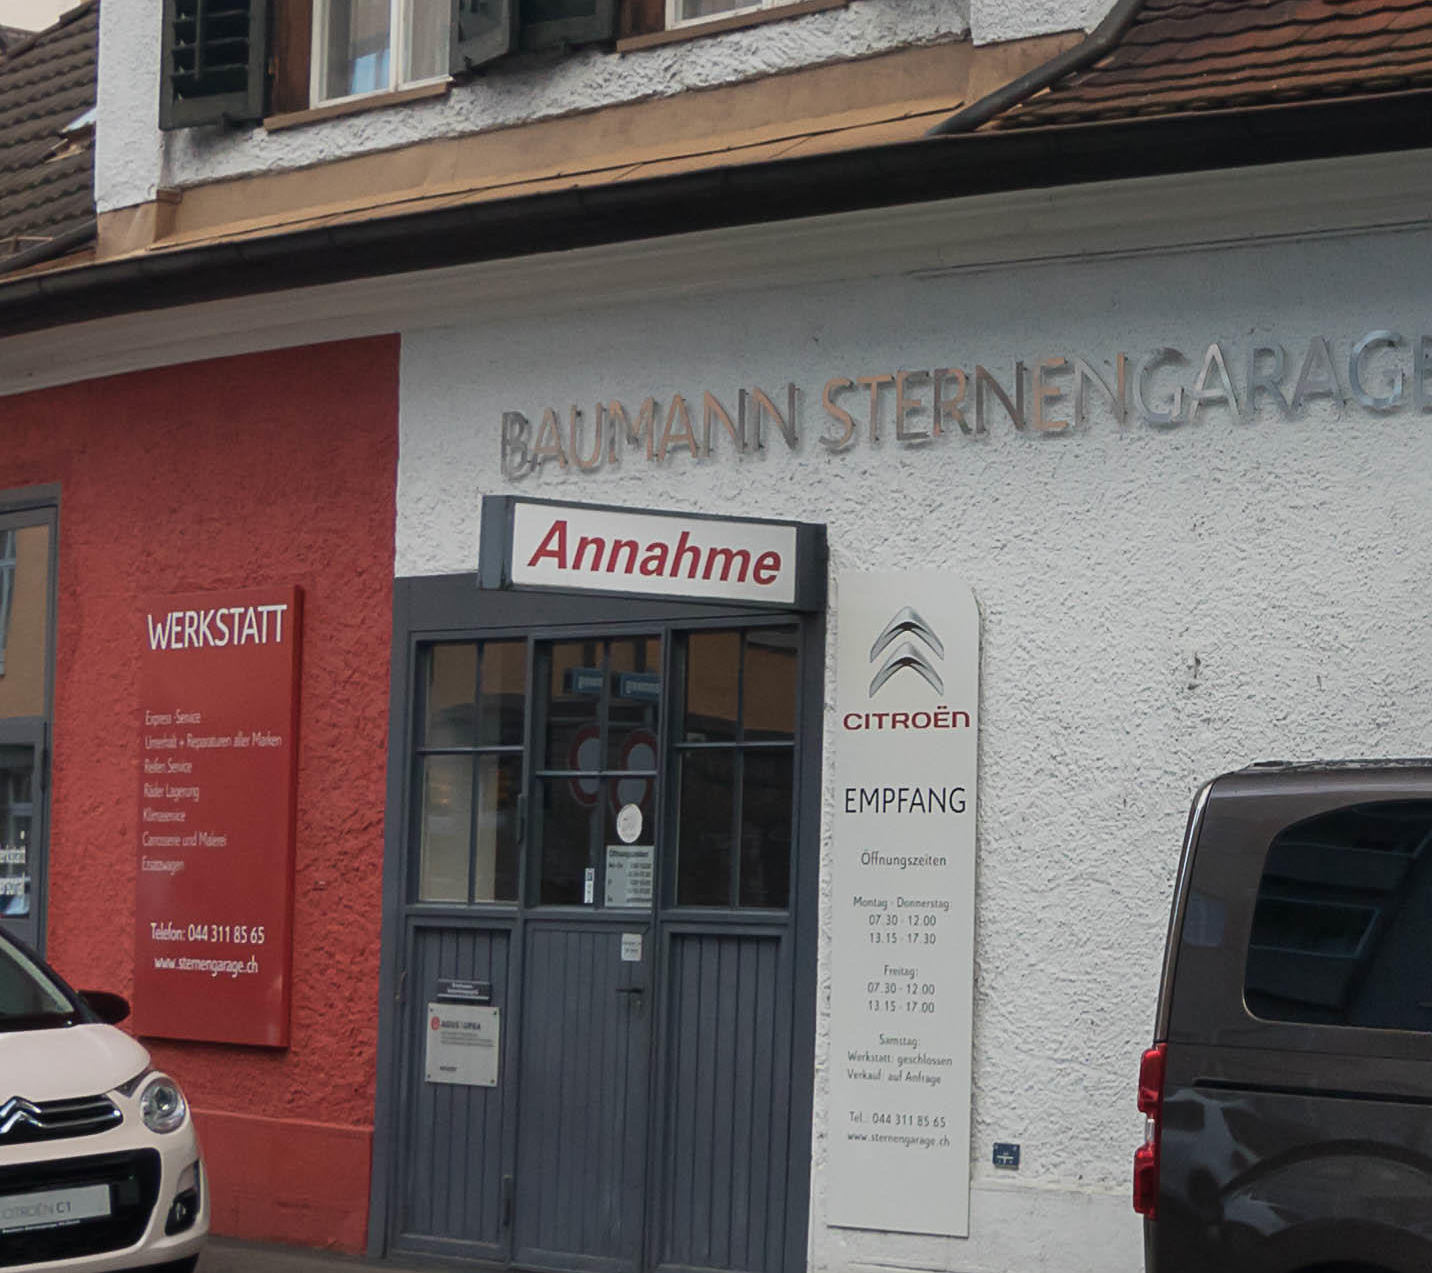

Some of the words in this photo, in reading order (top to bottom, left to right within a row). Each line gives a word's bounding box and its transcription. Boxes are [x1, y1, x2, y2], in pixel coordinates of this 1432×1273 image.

[500, 382, 800, 477] BAUMANN
[527, 519, 782, 586] Annahme
[147, 604, 288, 650] WERKSTATT
[252, 730, 282, 748] Marken
[845, 787, 967, 814] EMPFANG
[860, 848, 947, 870] Öffnungszeiten
[853, 895, 888, 911] Montag
[908, 914, 937, 927] 12.00
[150, 921, 186, 941] Telefon:
[187, 923, 208, 942] 044
[210, 924, 230, 943] 311
[233, 925, 248, 944] 85
[250, 926, 265, 944] 65
[869, 932, 897, 944] 13.15
[907, 932, 936, 945] 17.30
[154, 954, 258, 978] www.sternengarage.ch
[883, 964, 919, 980] Freitag:
[867, 982, 897, 994] 07.30
[879, 1033, 920, 1050] Samstag:
[847, 1051, 893, 1063] Werkstatt:
[897, 1053, 953, 1067] geschlossen
[888, 1069, 902, 1082] auf
[905, 1071, 941, 1087] Anfrage
[872, 1112, 891, 1125] 044
[895, 1114, 913, 1126] 311
[917, 1115, 929, 1127] 85
[933, 1116, 946, 1128] 65
[847, 1133, 950, 1148] www.sternengarage.ch
